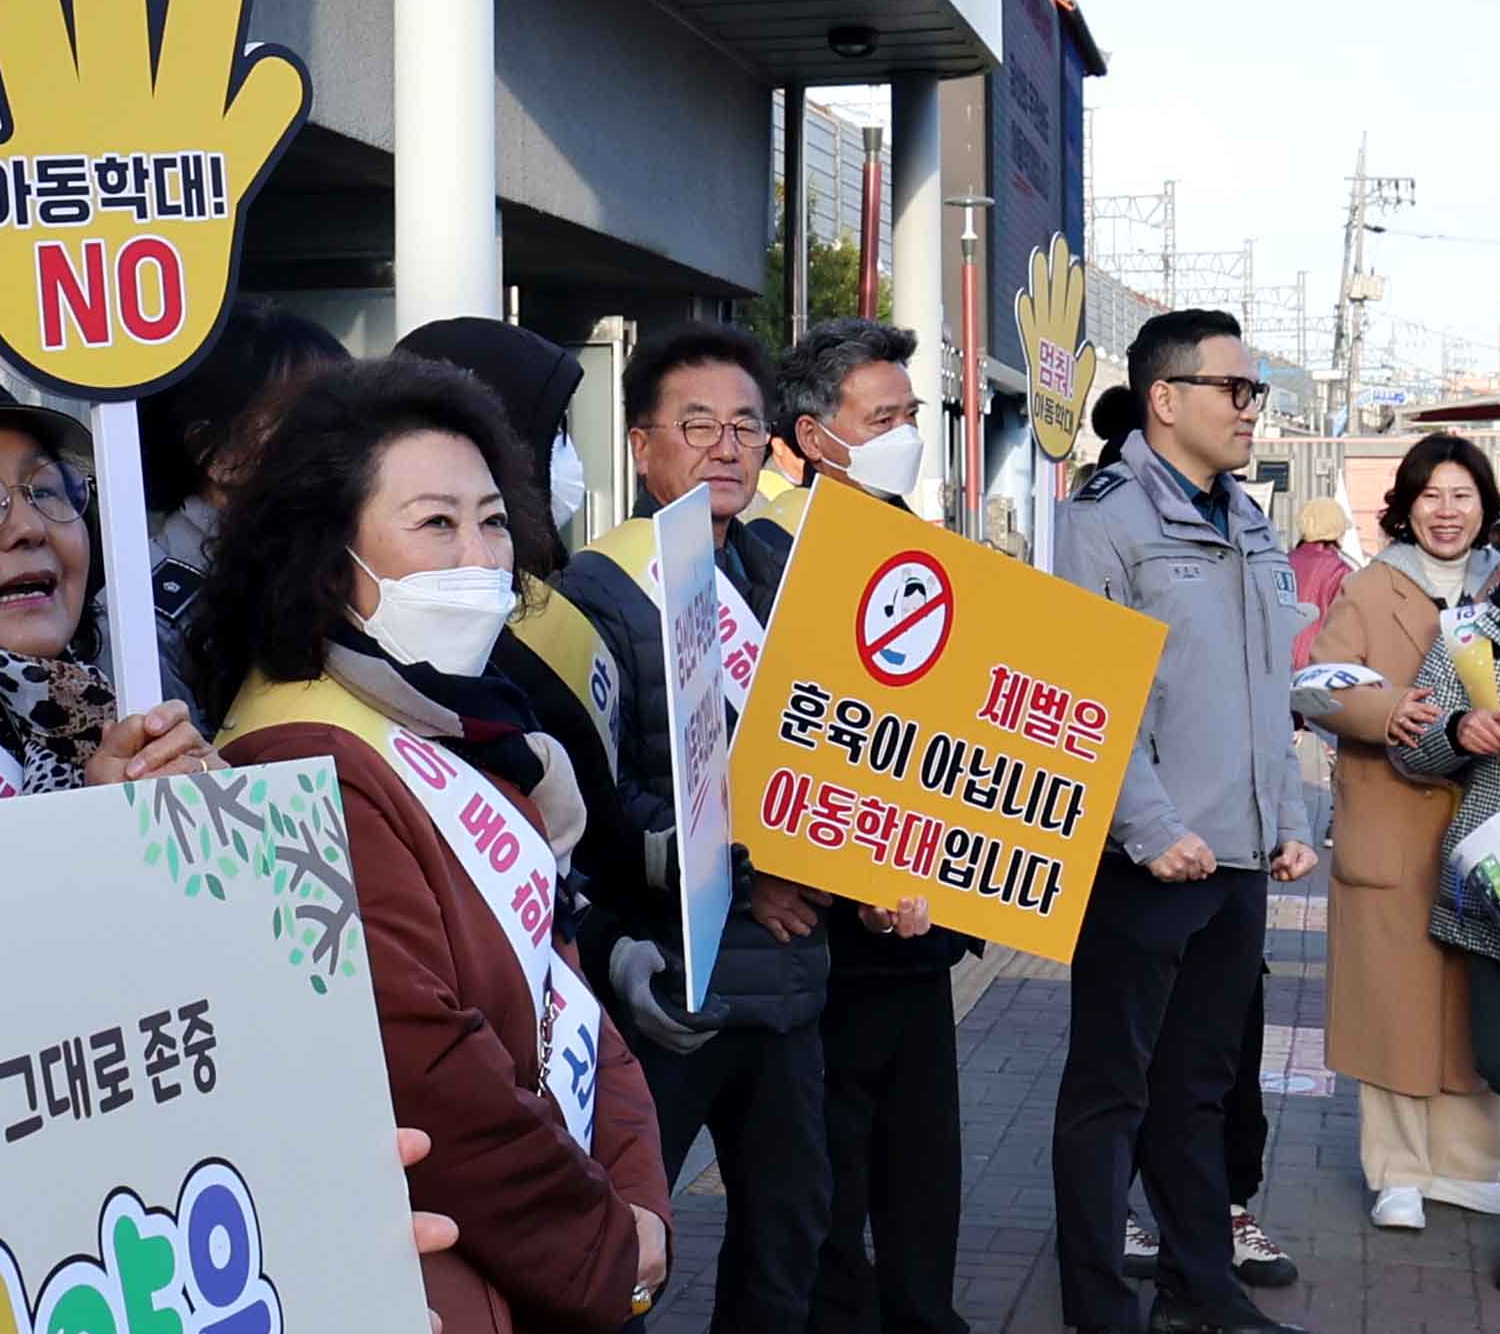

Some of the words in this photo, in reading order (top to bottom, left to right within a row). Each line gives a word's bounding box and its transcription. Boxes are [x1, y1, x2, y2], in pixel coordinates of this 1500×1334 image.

[38, 238, 184, 348] NO
[781, 682, 916, 779] 훈육이
[921, 734, 1084, 837] 아닙니다
[979, 667, 1108, 759] 체벌은
[762, 769, 1062, 916] 아동학대입니다
[140, 999, 218, 1104] 존중
